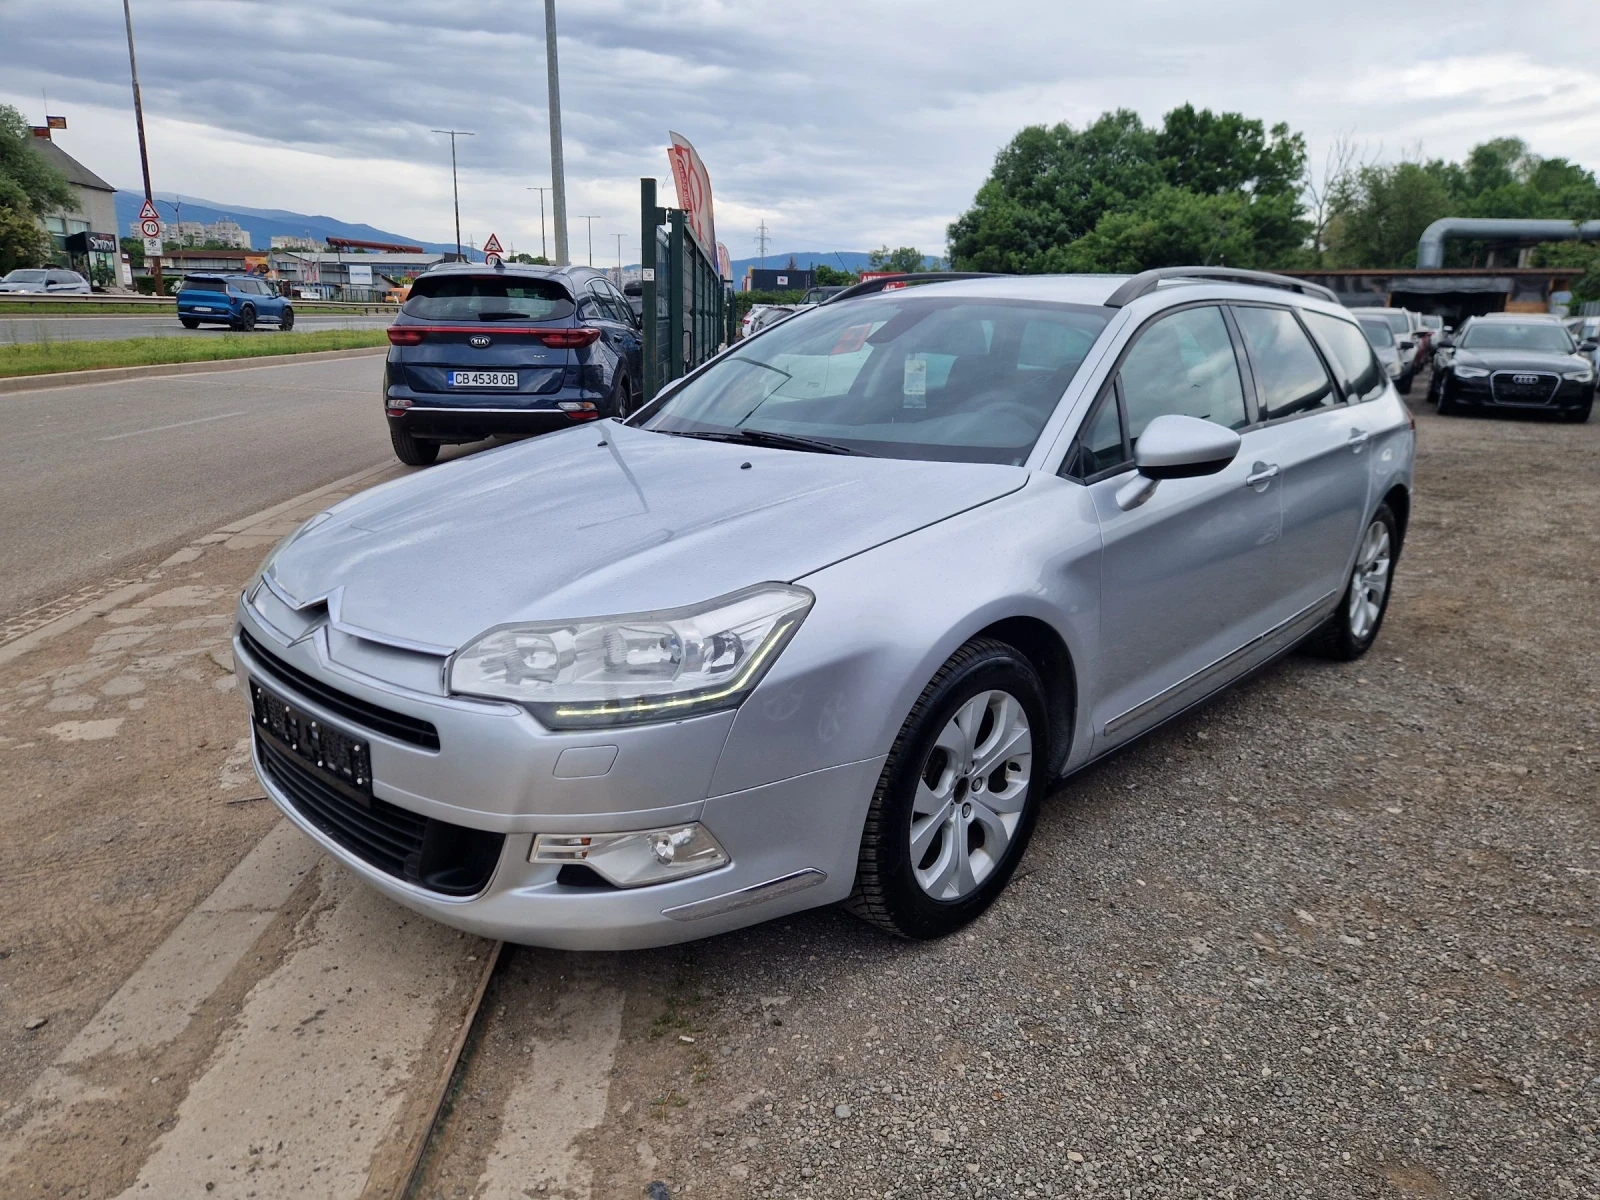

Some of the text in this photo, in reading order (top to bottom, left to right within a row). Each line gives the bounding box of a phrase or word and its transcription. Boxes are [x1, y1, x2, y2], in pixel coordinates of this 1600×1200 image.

[145, 223, 156, 233] 70
[455, 373, 469, 385] CB
[472, 373, 499, 385] 4538
